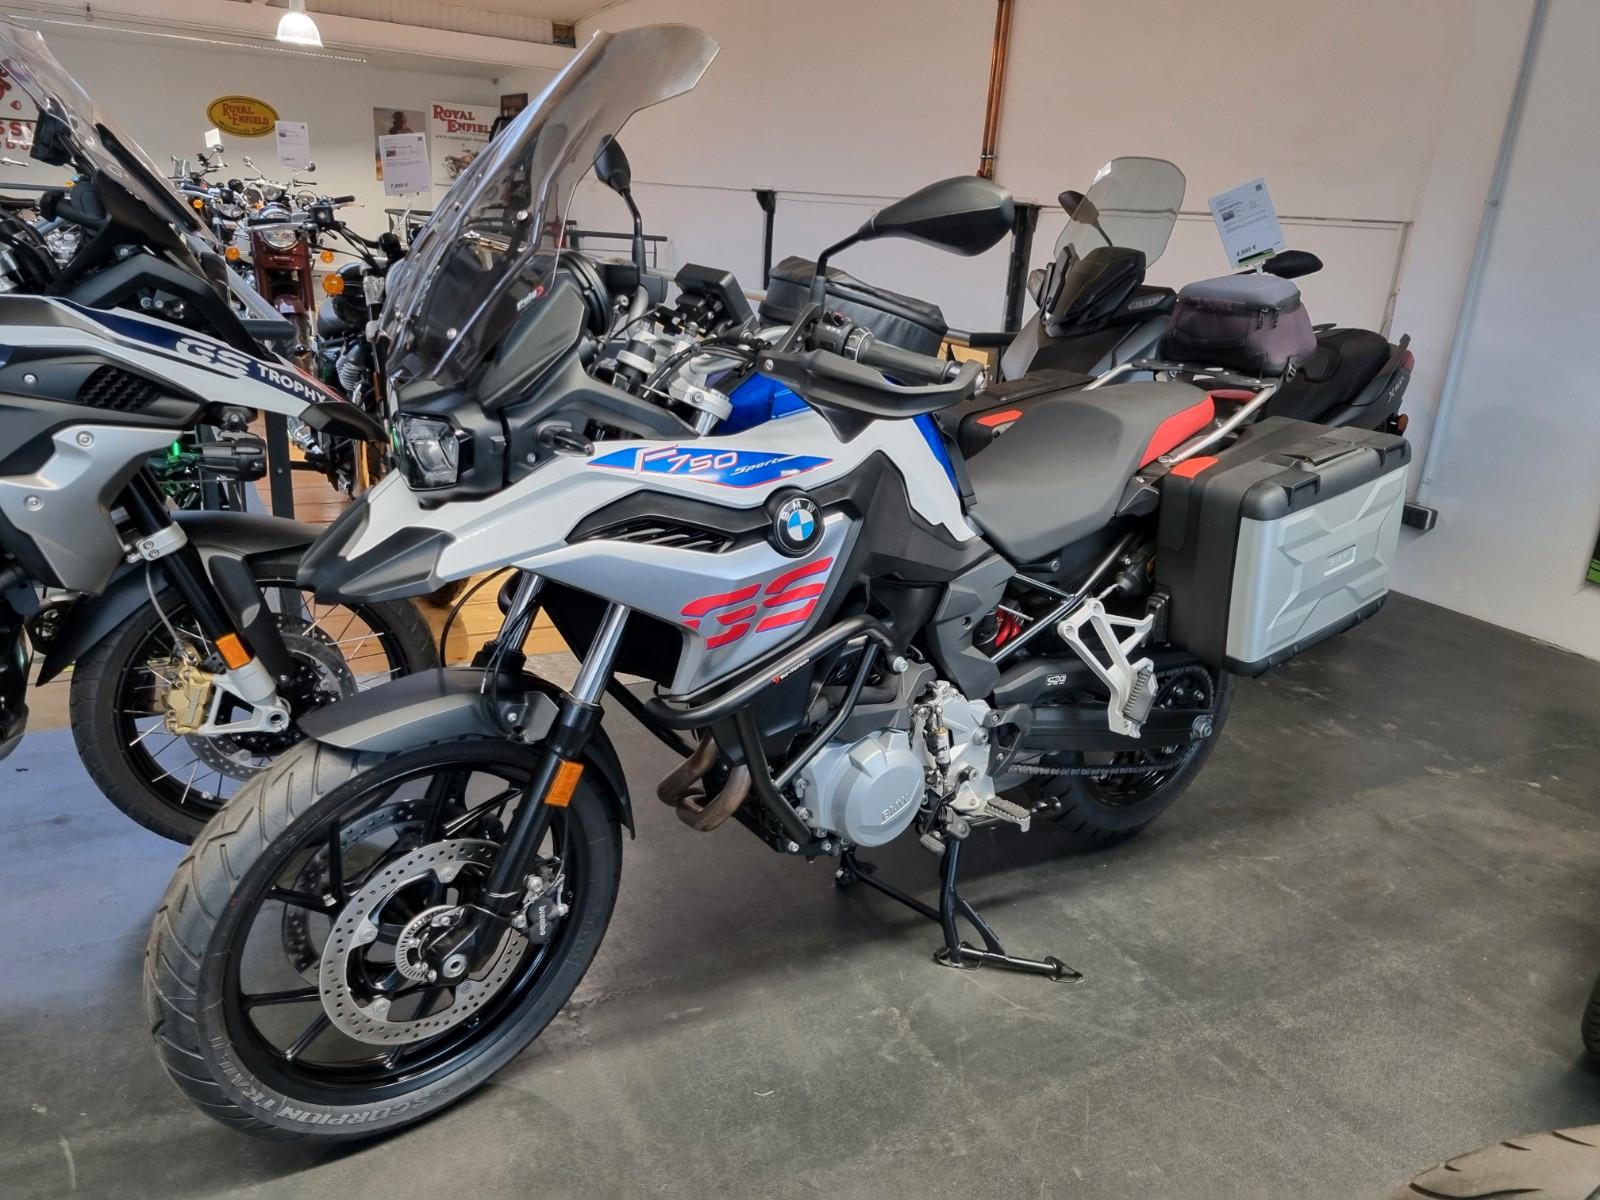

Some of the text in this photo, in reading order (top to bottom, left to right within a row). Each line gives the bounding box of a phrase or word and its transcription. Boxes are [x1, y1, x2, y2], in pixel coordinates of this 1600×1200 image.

[222, 102, 255, 116] ROYAL
[232, 114, 269, 126] ENFIELD
[432, 104, 475, 121] ROYAL
[256, 363, 327, 403] TROPHY
[780, 501, 817, 520] BMW
[680, 556, 834, 651] GS
[539, 904, 549, 936] brembo
[278, 1091, 434, 1126] SCORPION
